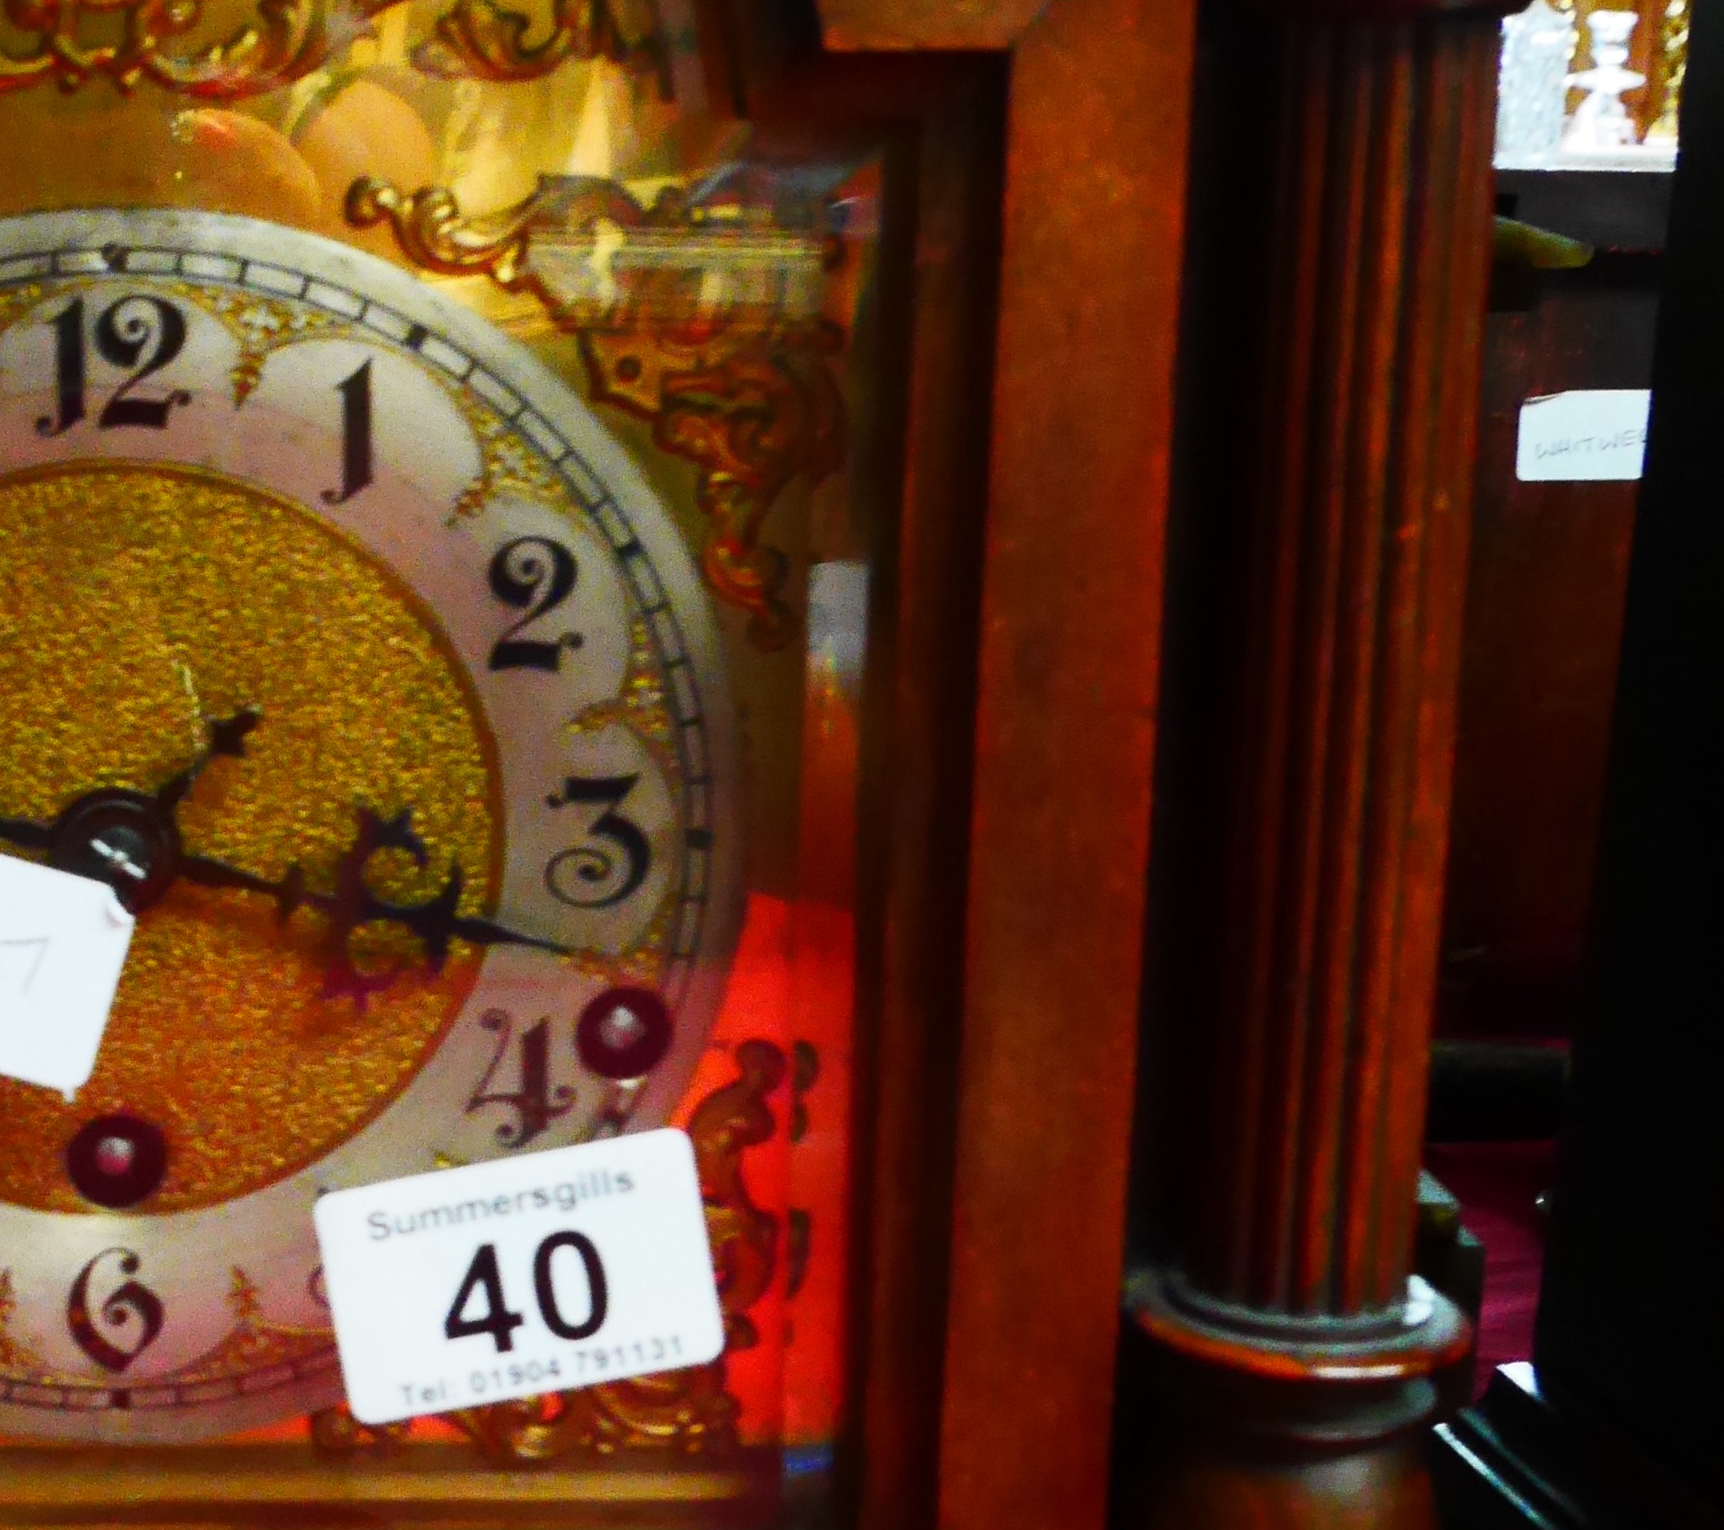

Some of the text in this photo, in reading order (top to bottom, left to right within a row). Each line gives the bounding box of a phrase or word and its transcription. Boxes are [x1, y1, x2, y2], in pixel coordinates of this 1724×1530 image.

[36, 293, 189, 434] 12
[321, 357, 374, 504] 1
[489, 535, 582, 670] 2
[545, 774, 651, 908] 3
[465, 1008, 574, 1150] 4
[367, 1167, 636, 1241] Summersgills
[67, 1246, 165, 1372] 6
[444, 1229, 609, 1353] 40
[400, 1335, 684, 1407] Tel: 01904 791131
